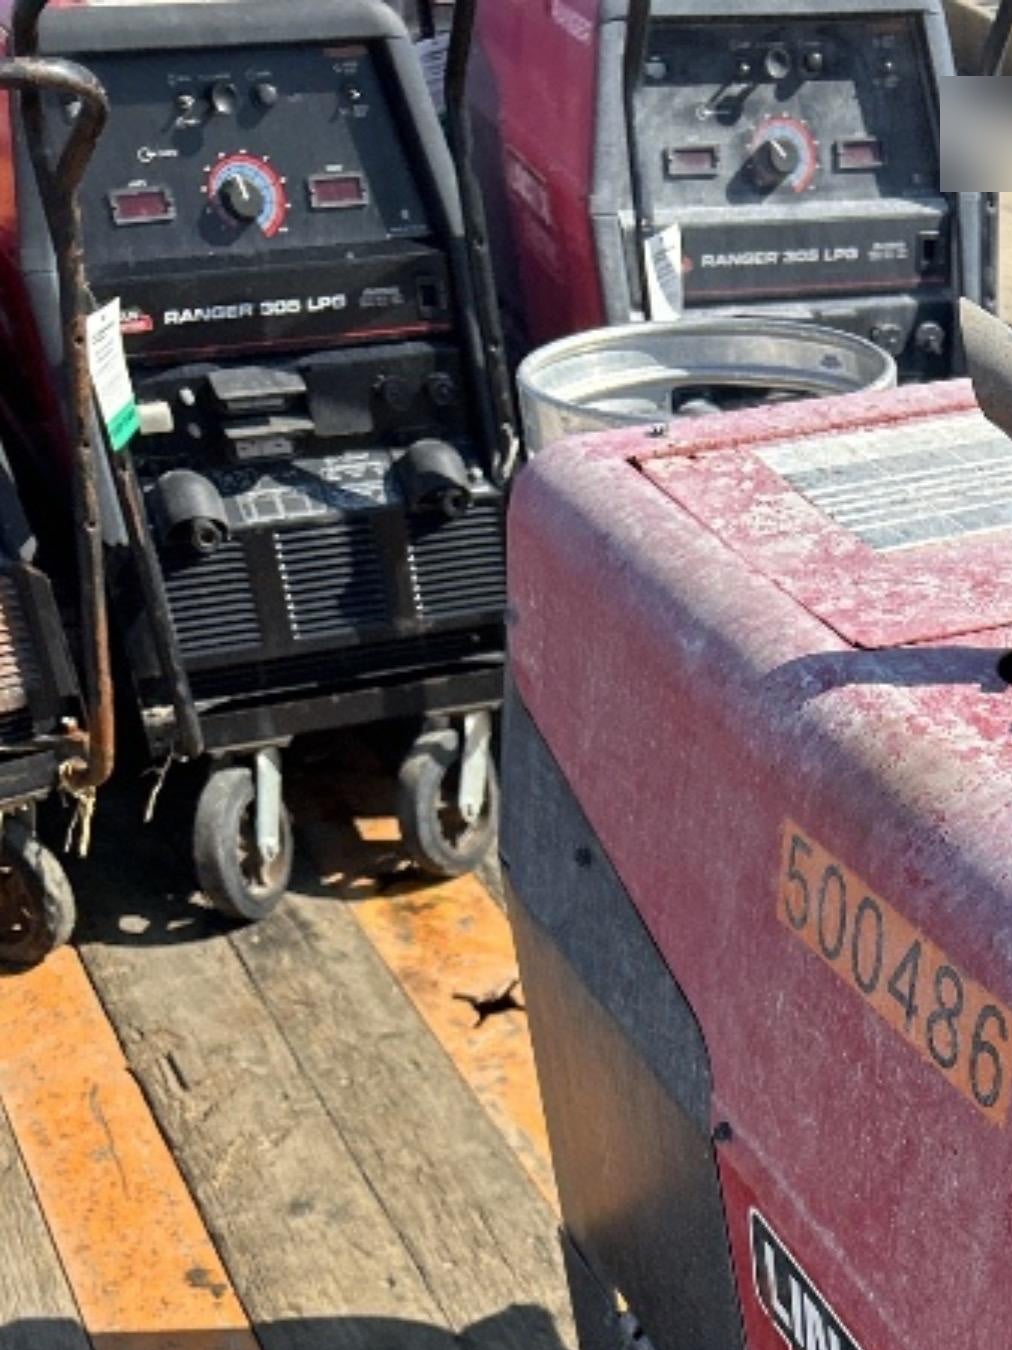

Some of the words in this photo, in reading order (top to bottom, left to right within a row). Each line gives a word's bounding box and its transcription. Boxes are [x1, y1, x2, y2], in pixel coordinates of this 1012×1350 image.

[701, 250, 778, 268] RANGER
[782, 248, 819, 263] 305
[163, 302, 252, 325] RANGER
[259, 299, 301, 316] 305
[784, 832, 1009, 1109] 500486
